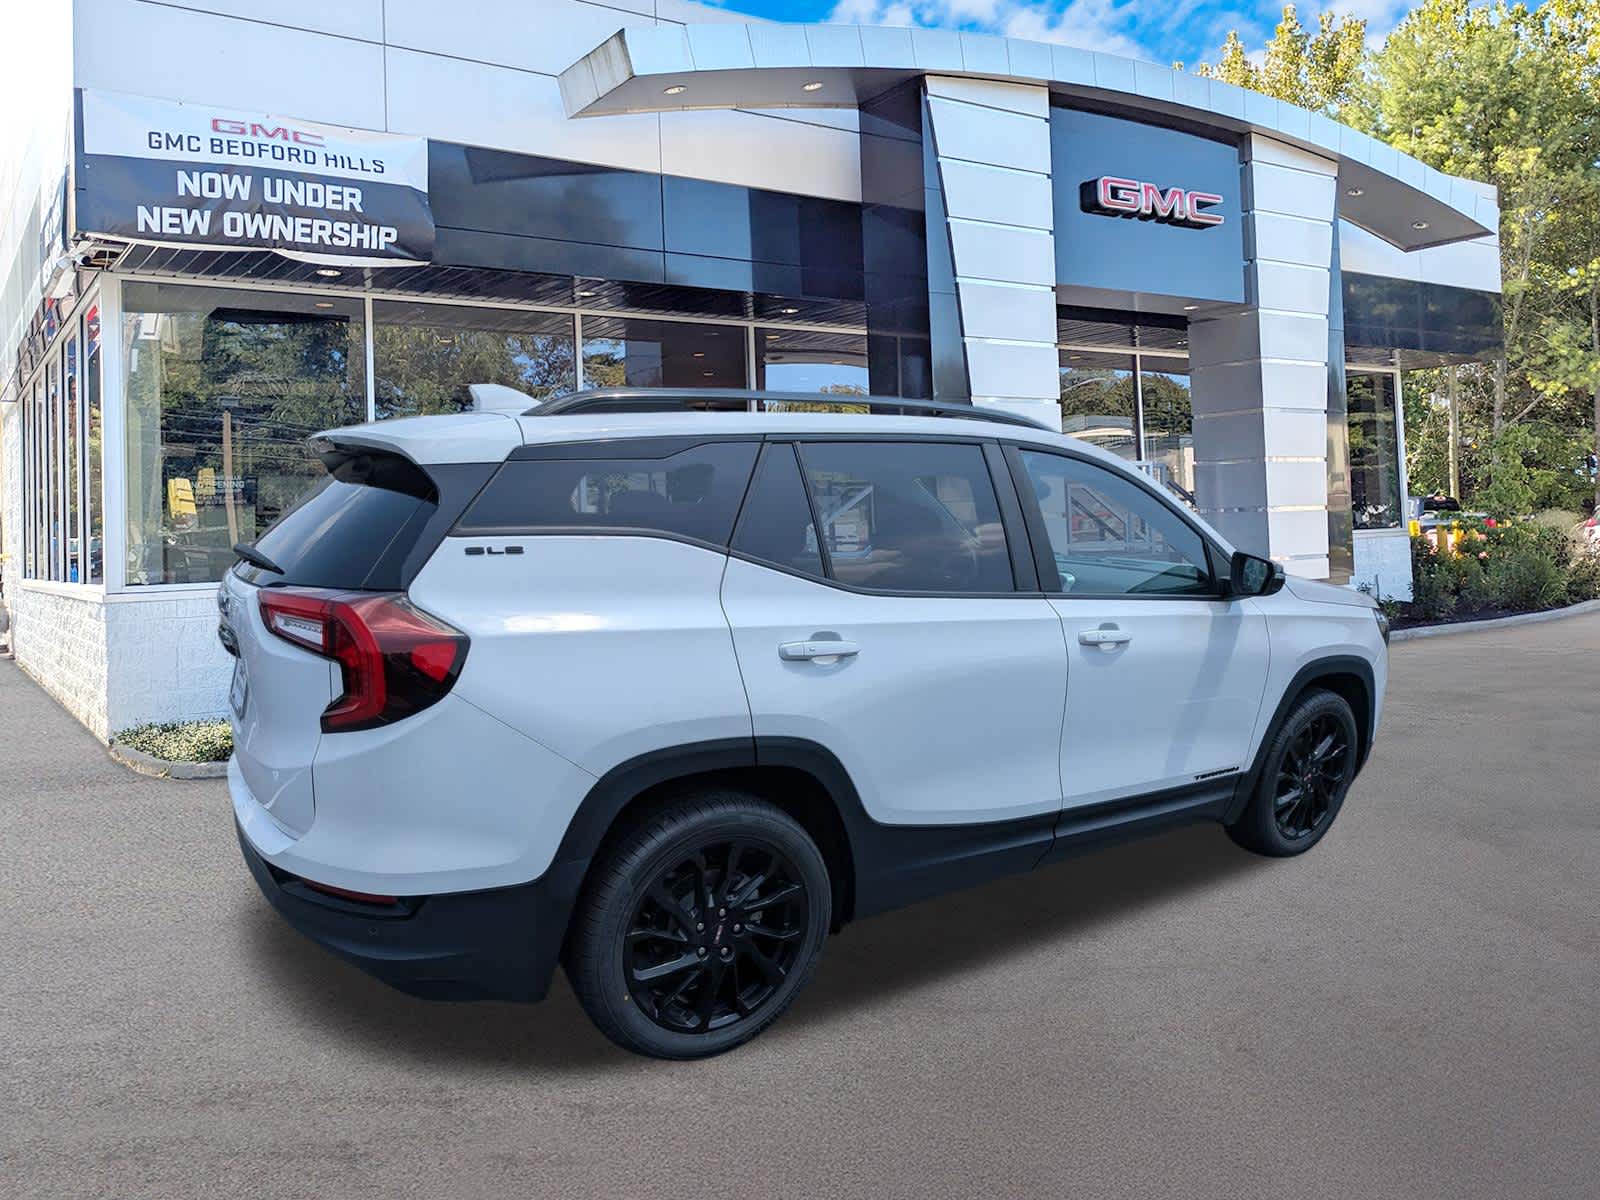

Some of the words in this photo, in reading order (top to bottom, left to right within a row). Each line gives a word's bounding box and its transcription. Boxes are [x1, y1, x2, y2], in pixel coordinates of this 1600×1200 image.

[148, 131, 201, 153] GMC
[210, 137, 316, 166] BEDFORD
[324, 153, 385, 174] HILLS
[211, 118, 326, 148] GMC
[177, 170, 252, 201] NOW
[263, 177, 363, 213] UNDER
[1097, 175, 1225, 225] GMC
[137, 205, 212, 236] NEW
[223, 211, 398, 251] OWNERSHIP
